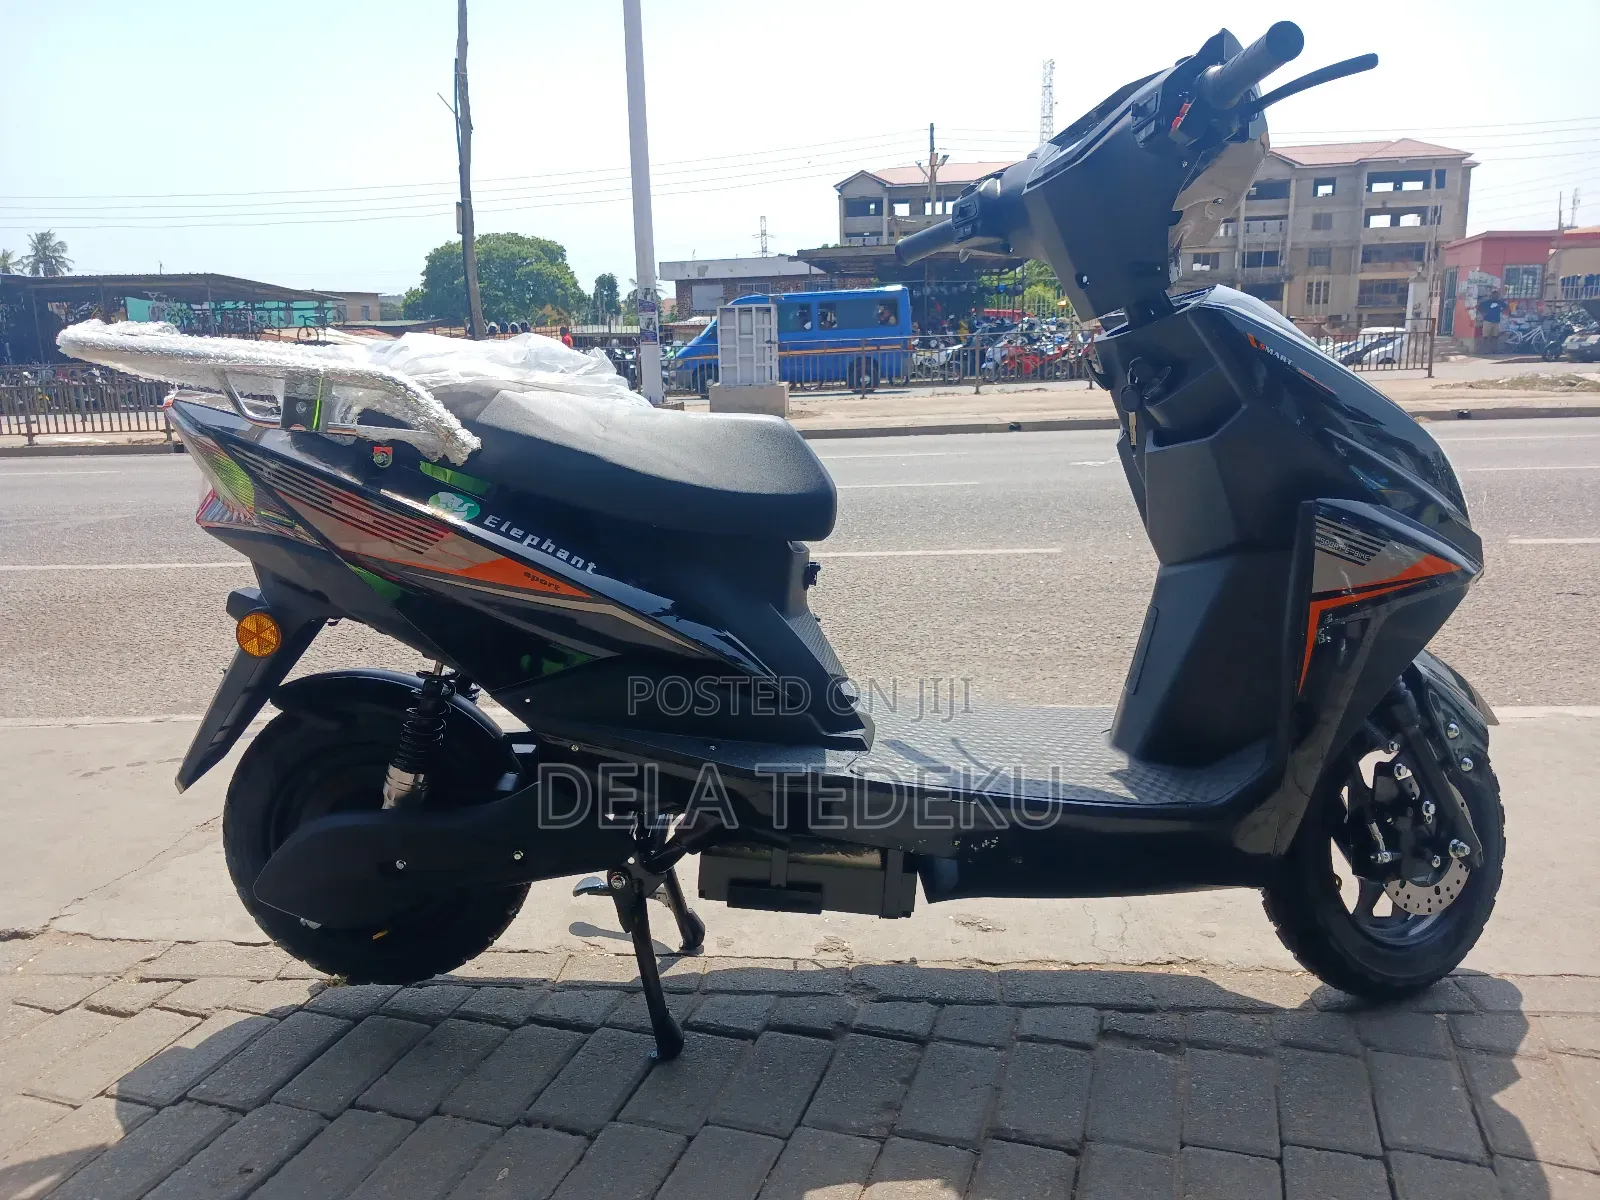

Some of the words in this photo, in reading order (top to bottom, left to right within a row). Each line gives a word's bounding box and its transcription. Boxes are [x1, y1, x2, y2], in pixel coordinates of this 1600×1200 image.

[1260, 342, 1293, 366] SMART
[483, 514, 597, 575] Elephant
[523, 571, 561, 592] sport
